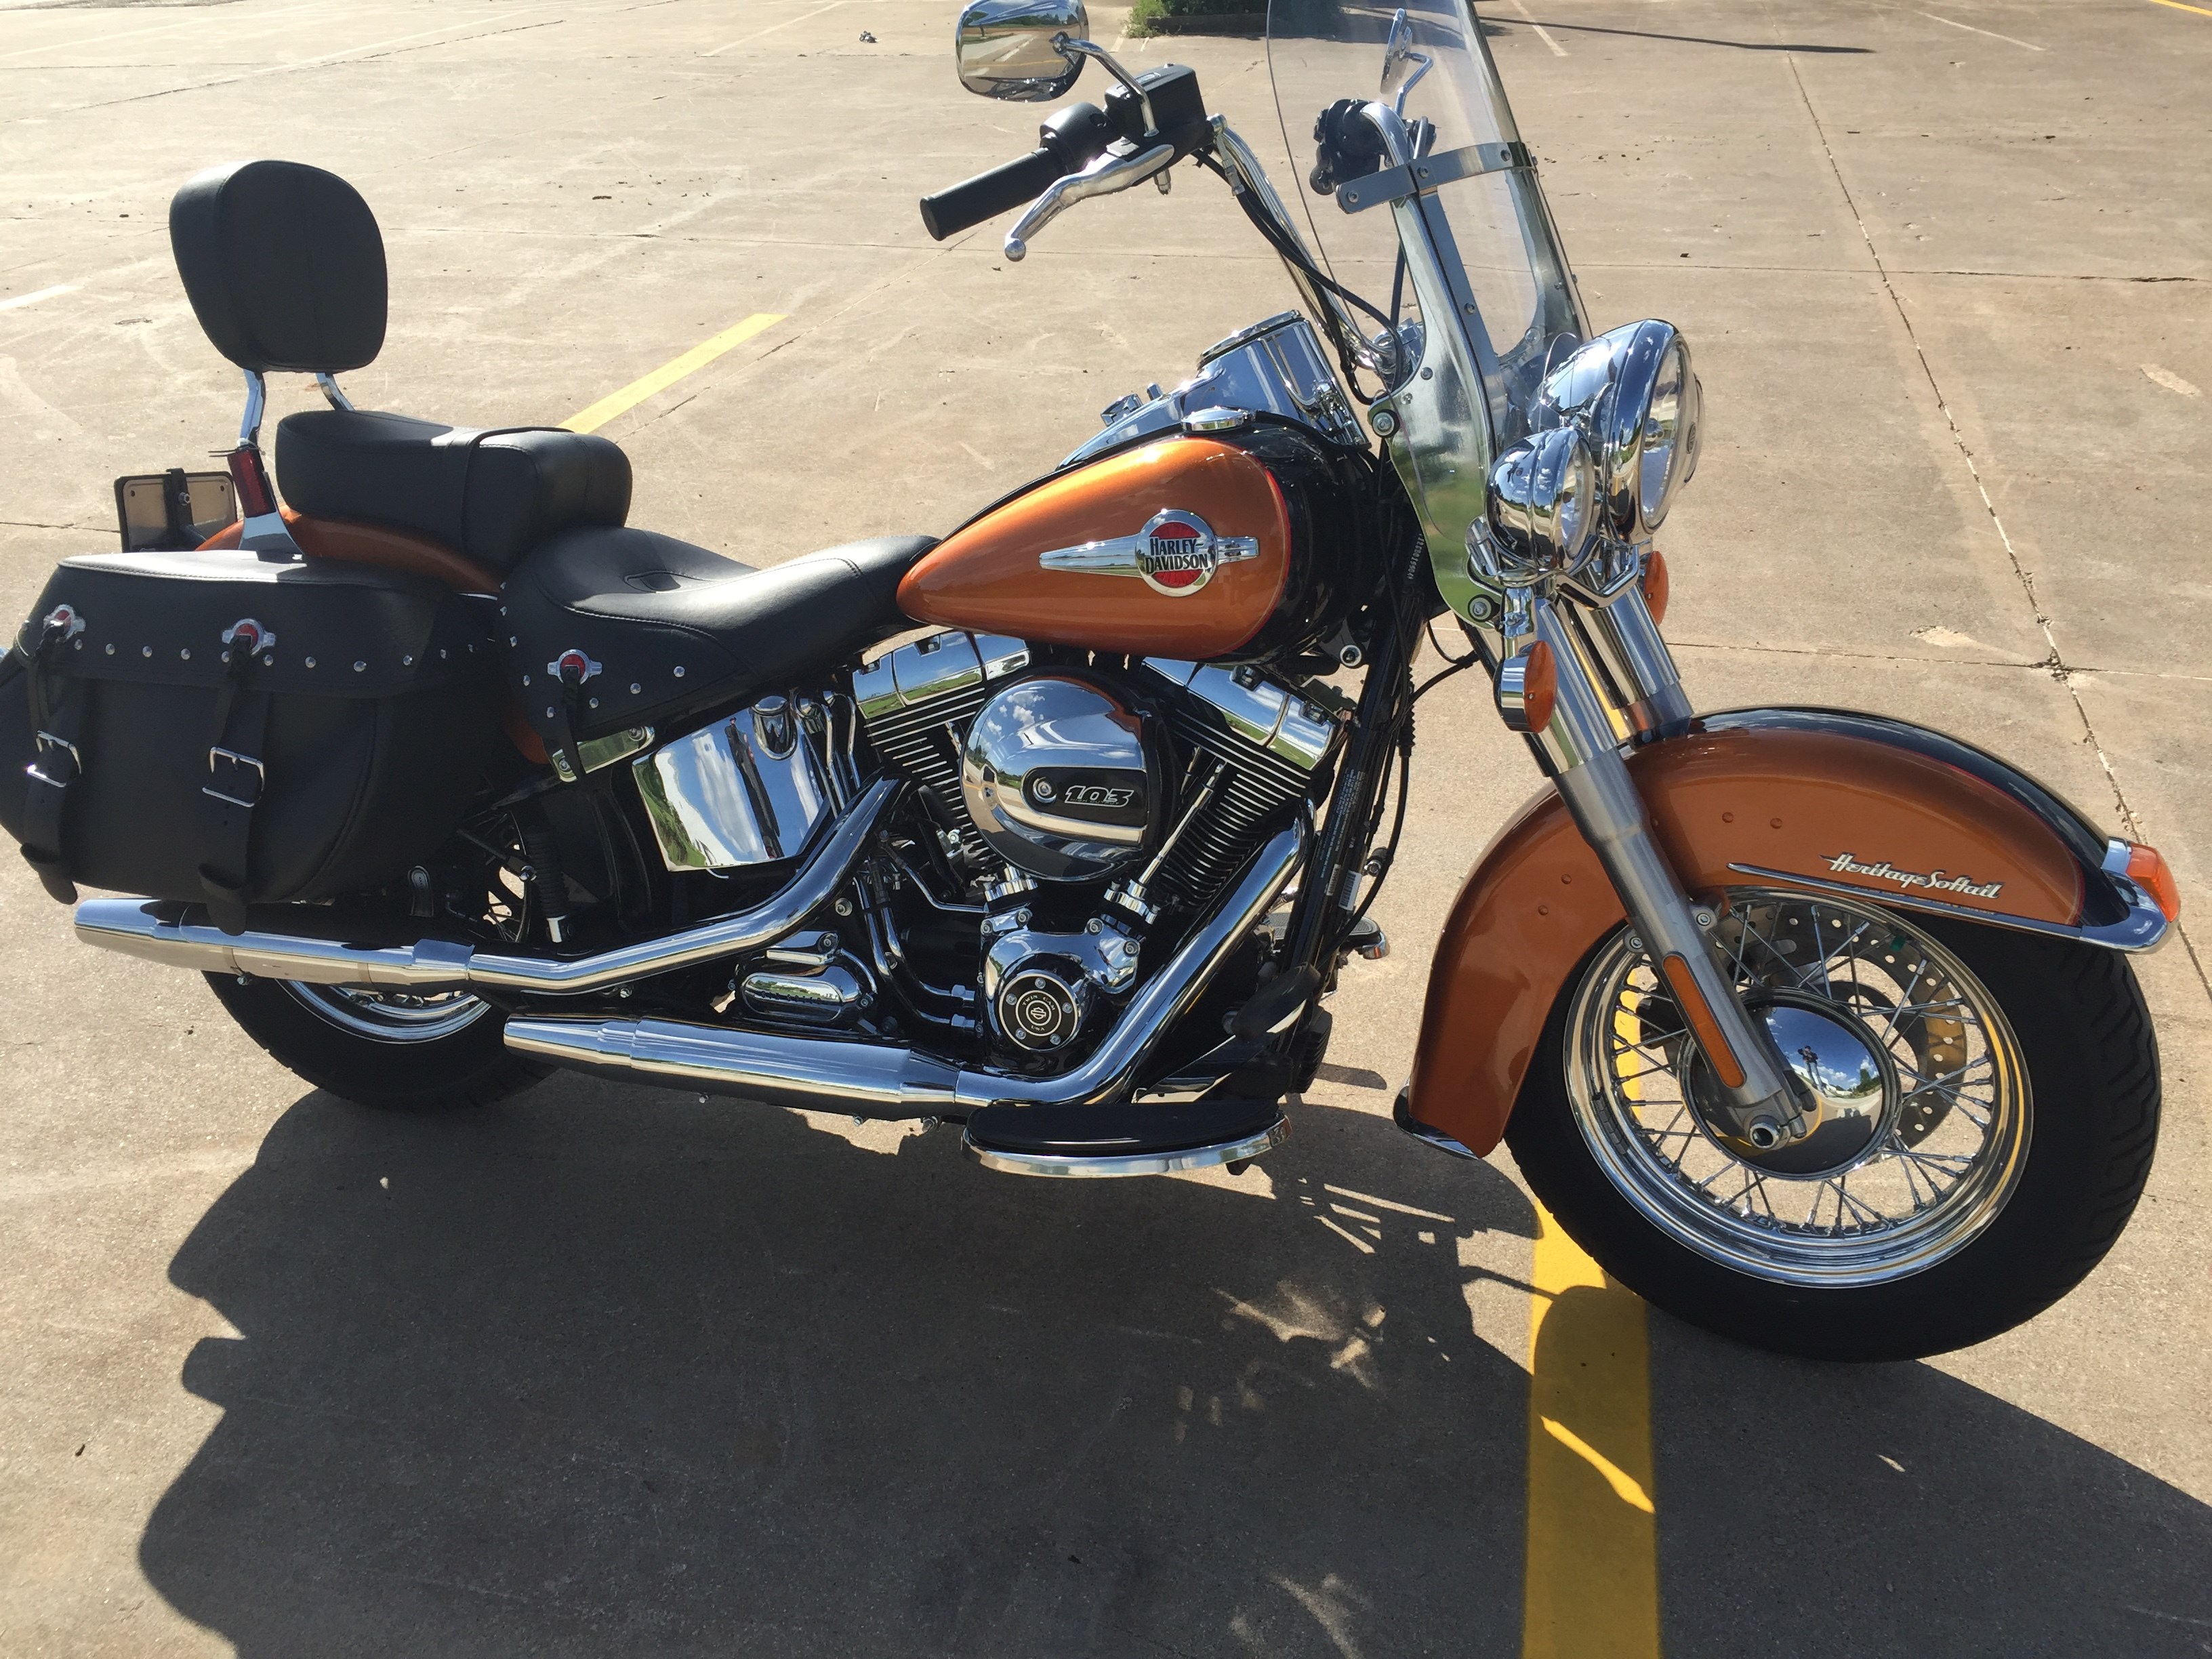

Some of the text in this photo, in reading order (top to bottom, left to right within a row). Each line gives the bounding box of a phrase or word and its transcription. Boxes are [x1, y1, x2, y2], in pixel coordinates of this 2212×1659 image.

[1149, 537, 1204, 556] HARLEY-
[1145, 553, 1208, 574] DAVIDSON
[1065, 785, 1134, 807] 103
[1820, 852, 2004, 899] Heritage Softail
[1022, 995, 1055, 1010] TWIN CAM
